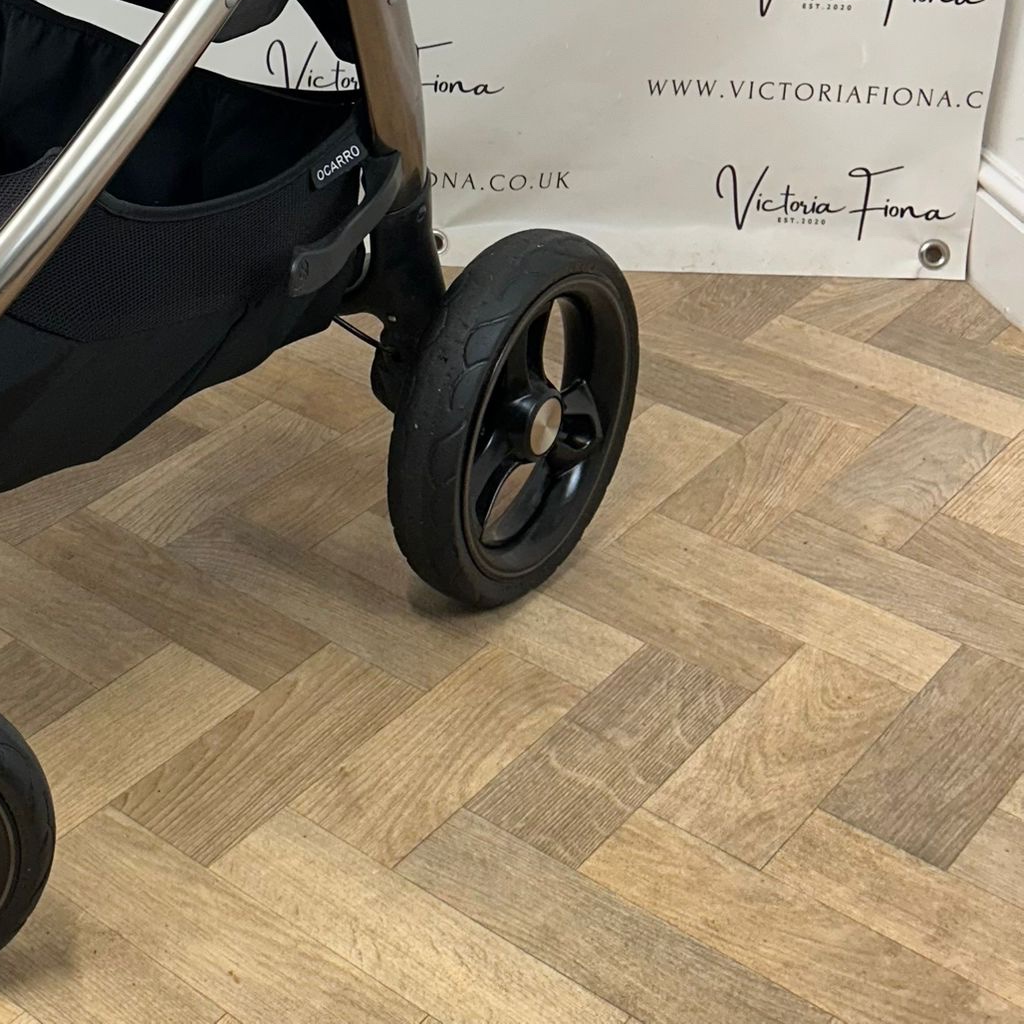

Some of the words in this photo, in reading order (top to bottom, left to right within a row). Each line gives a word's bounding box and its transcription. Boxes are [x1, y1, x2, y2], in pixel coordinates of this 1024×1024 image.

[802, 3, 852, 11] EST.2020
[266, 40, 359, 89] Victor
[647, 79, 983, 109] WWW.VICTORIAFIONA.C
[316, 145, 360, 181] OCARRO
[716, 164, 846, 230] Victoria
[848, 166, 956, 241] Fiona
